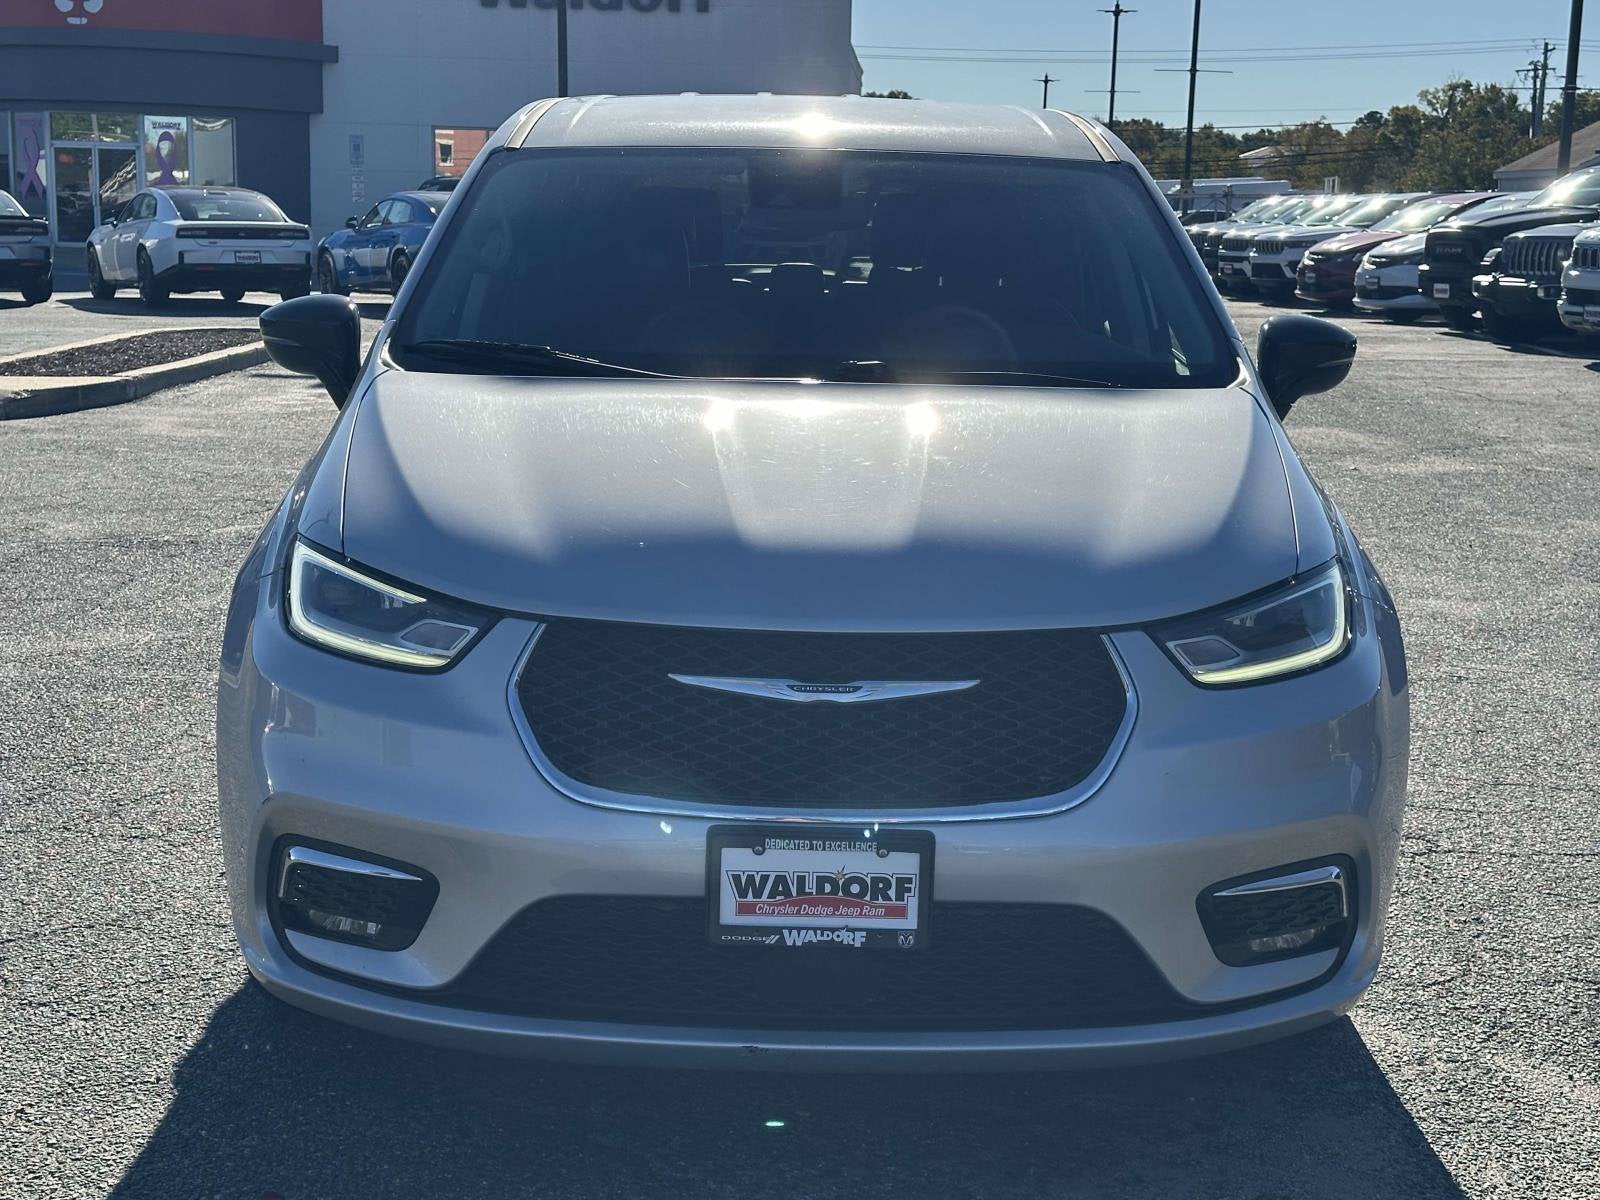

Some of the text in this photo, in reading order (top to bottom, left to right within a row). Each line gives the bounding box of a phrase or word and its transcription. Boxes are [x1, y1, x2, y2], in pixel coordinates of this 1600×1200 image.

[765, 838, 878, 852] DEDICATED TO EXCELLENCE
[728, 871, 915, 904] WALDORF
[755, 903, 886, 917] Chrysler Dodge Jeep Ram
[782, 929, 867, 948] WALDORF
